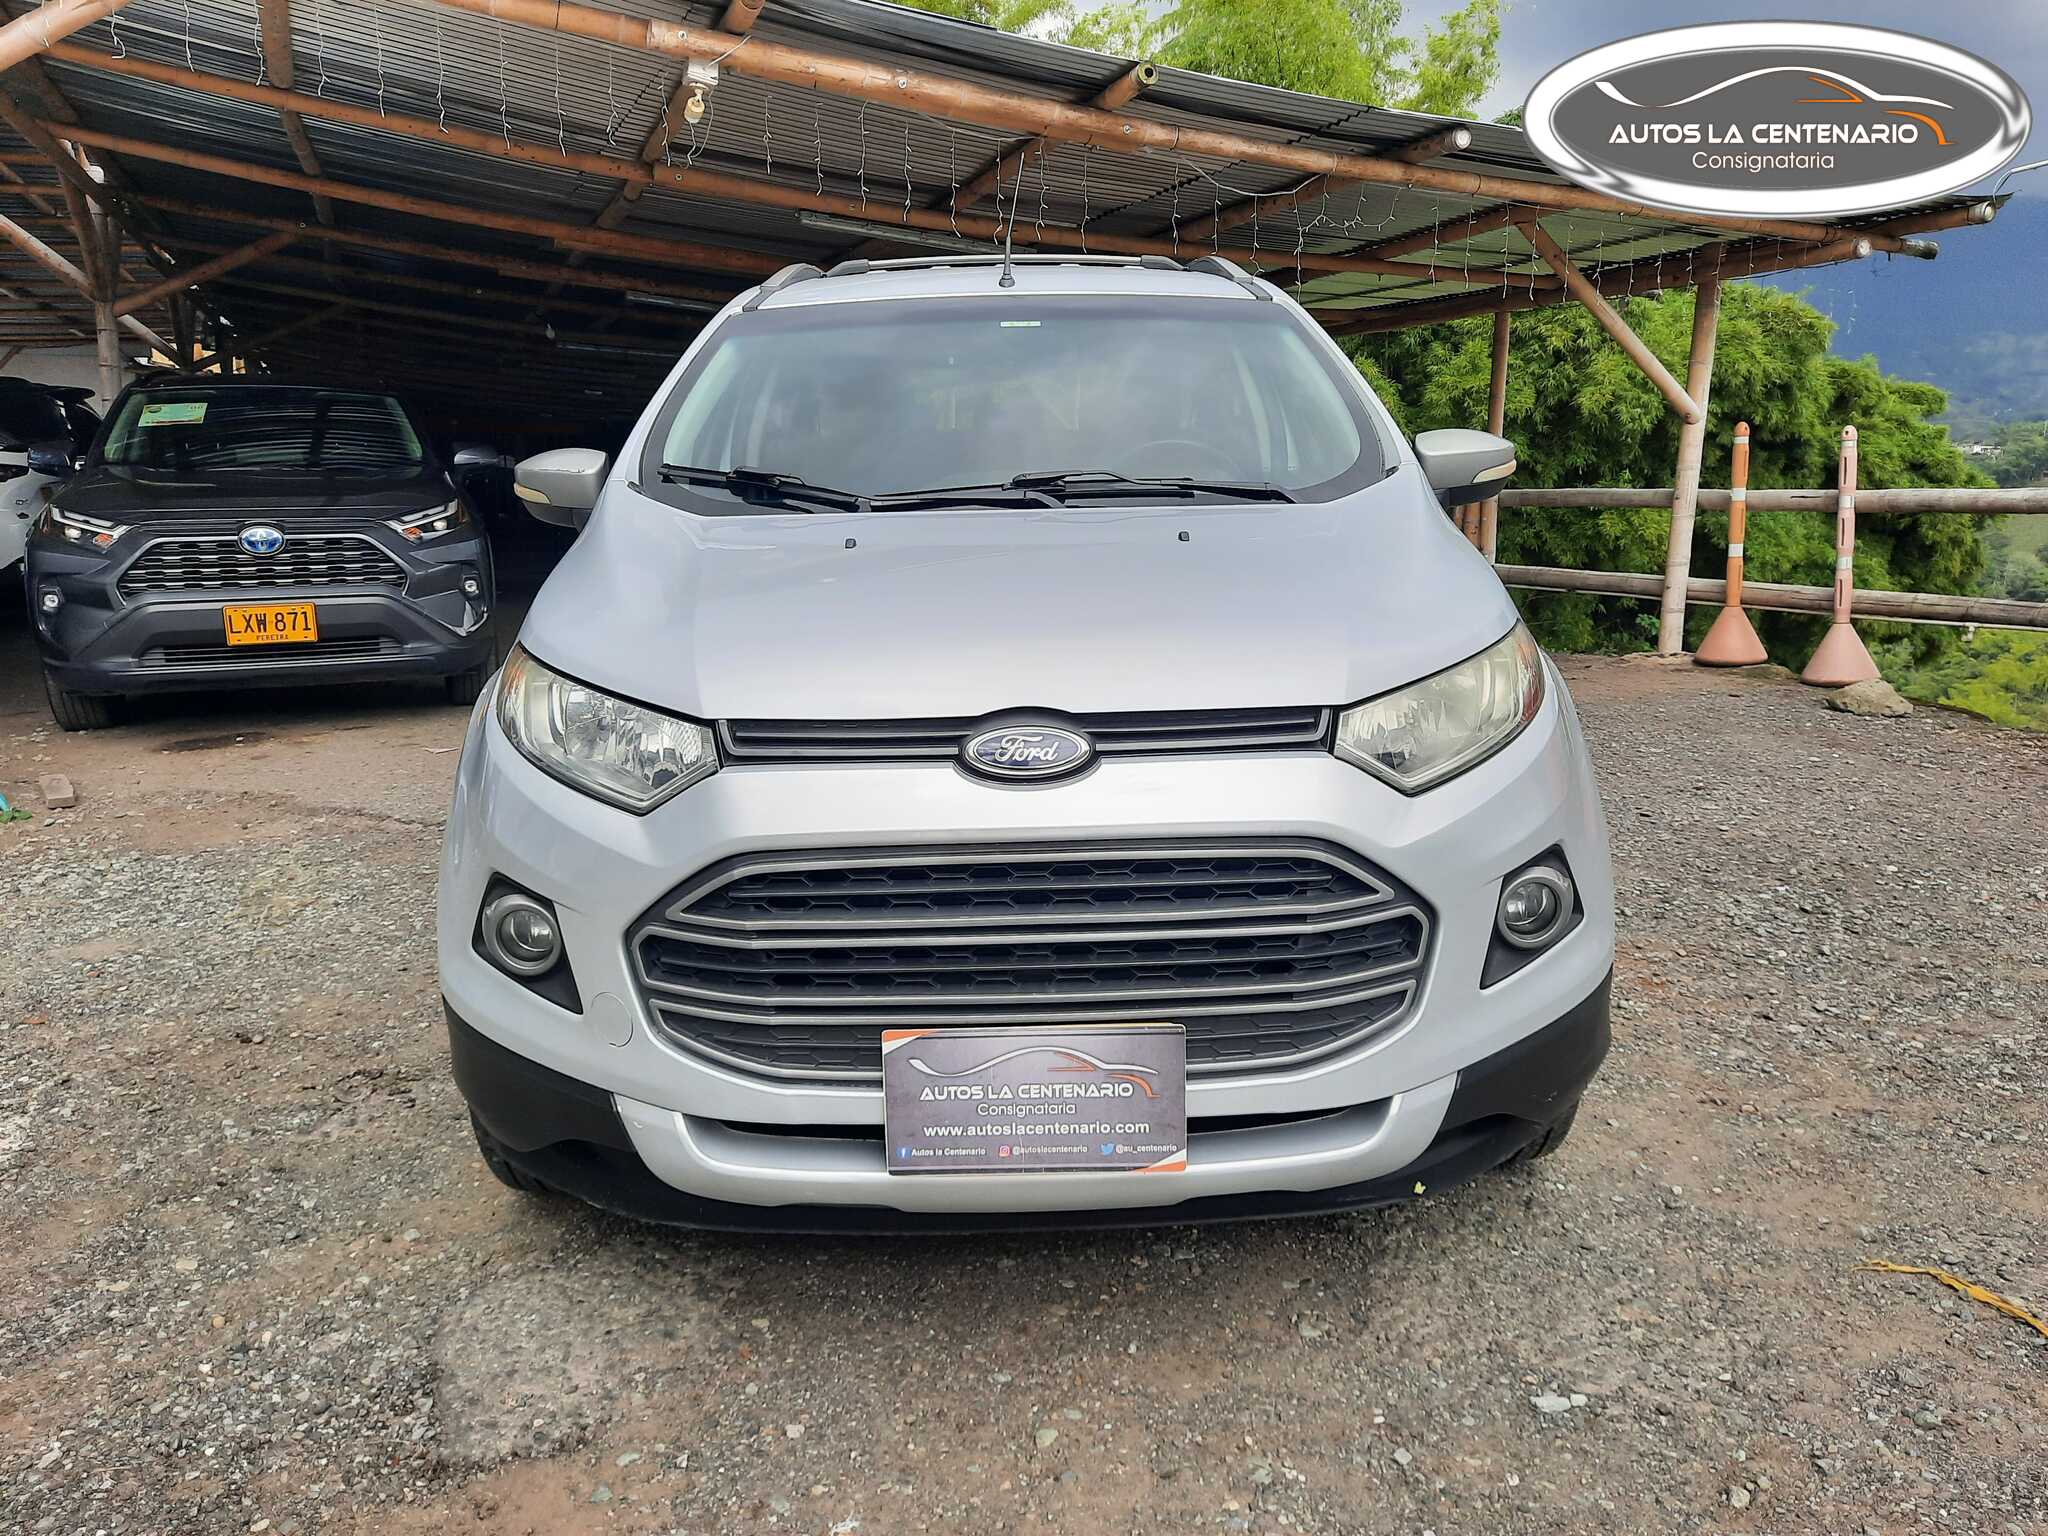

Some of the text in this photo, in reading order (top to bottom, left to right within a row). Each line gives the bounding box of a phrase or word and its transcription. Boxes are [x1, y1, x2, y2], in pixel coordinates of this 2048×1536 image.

[228, 611, 311, 634] LXW 871
[994, 735, 1060, 761] Ford
[919, 1082, 1134, 1101] AUTOS LA CENTENARIO
[977, 1102, 1077, 1117] Consignataria
[923, 1120, 1151, 1137] www.autoslacentenario.com
[911, 1147, 934, 1157] Autos
[944, 1146, 986, 1156] Centenario
